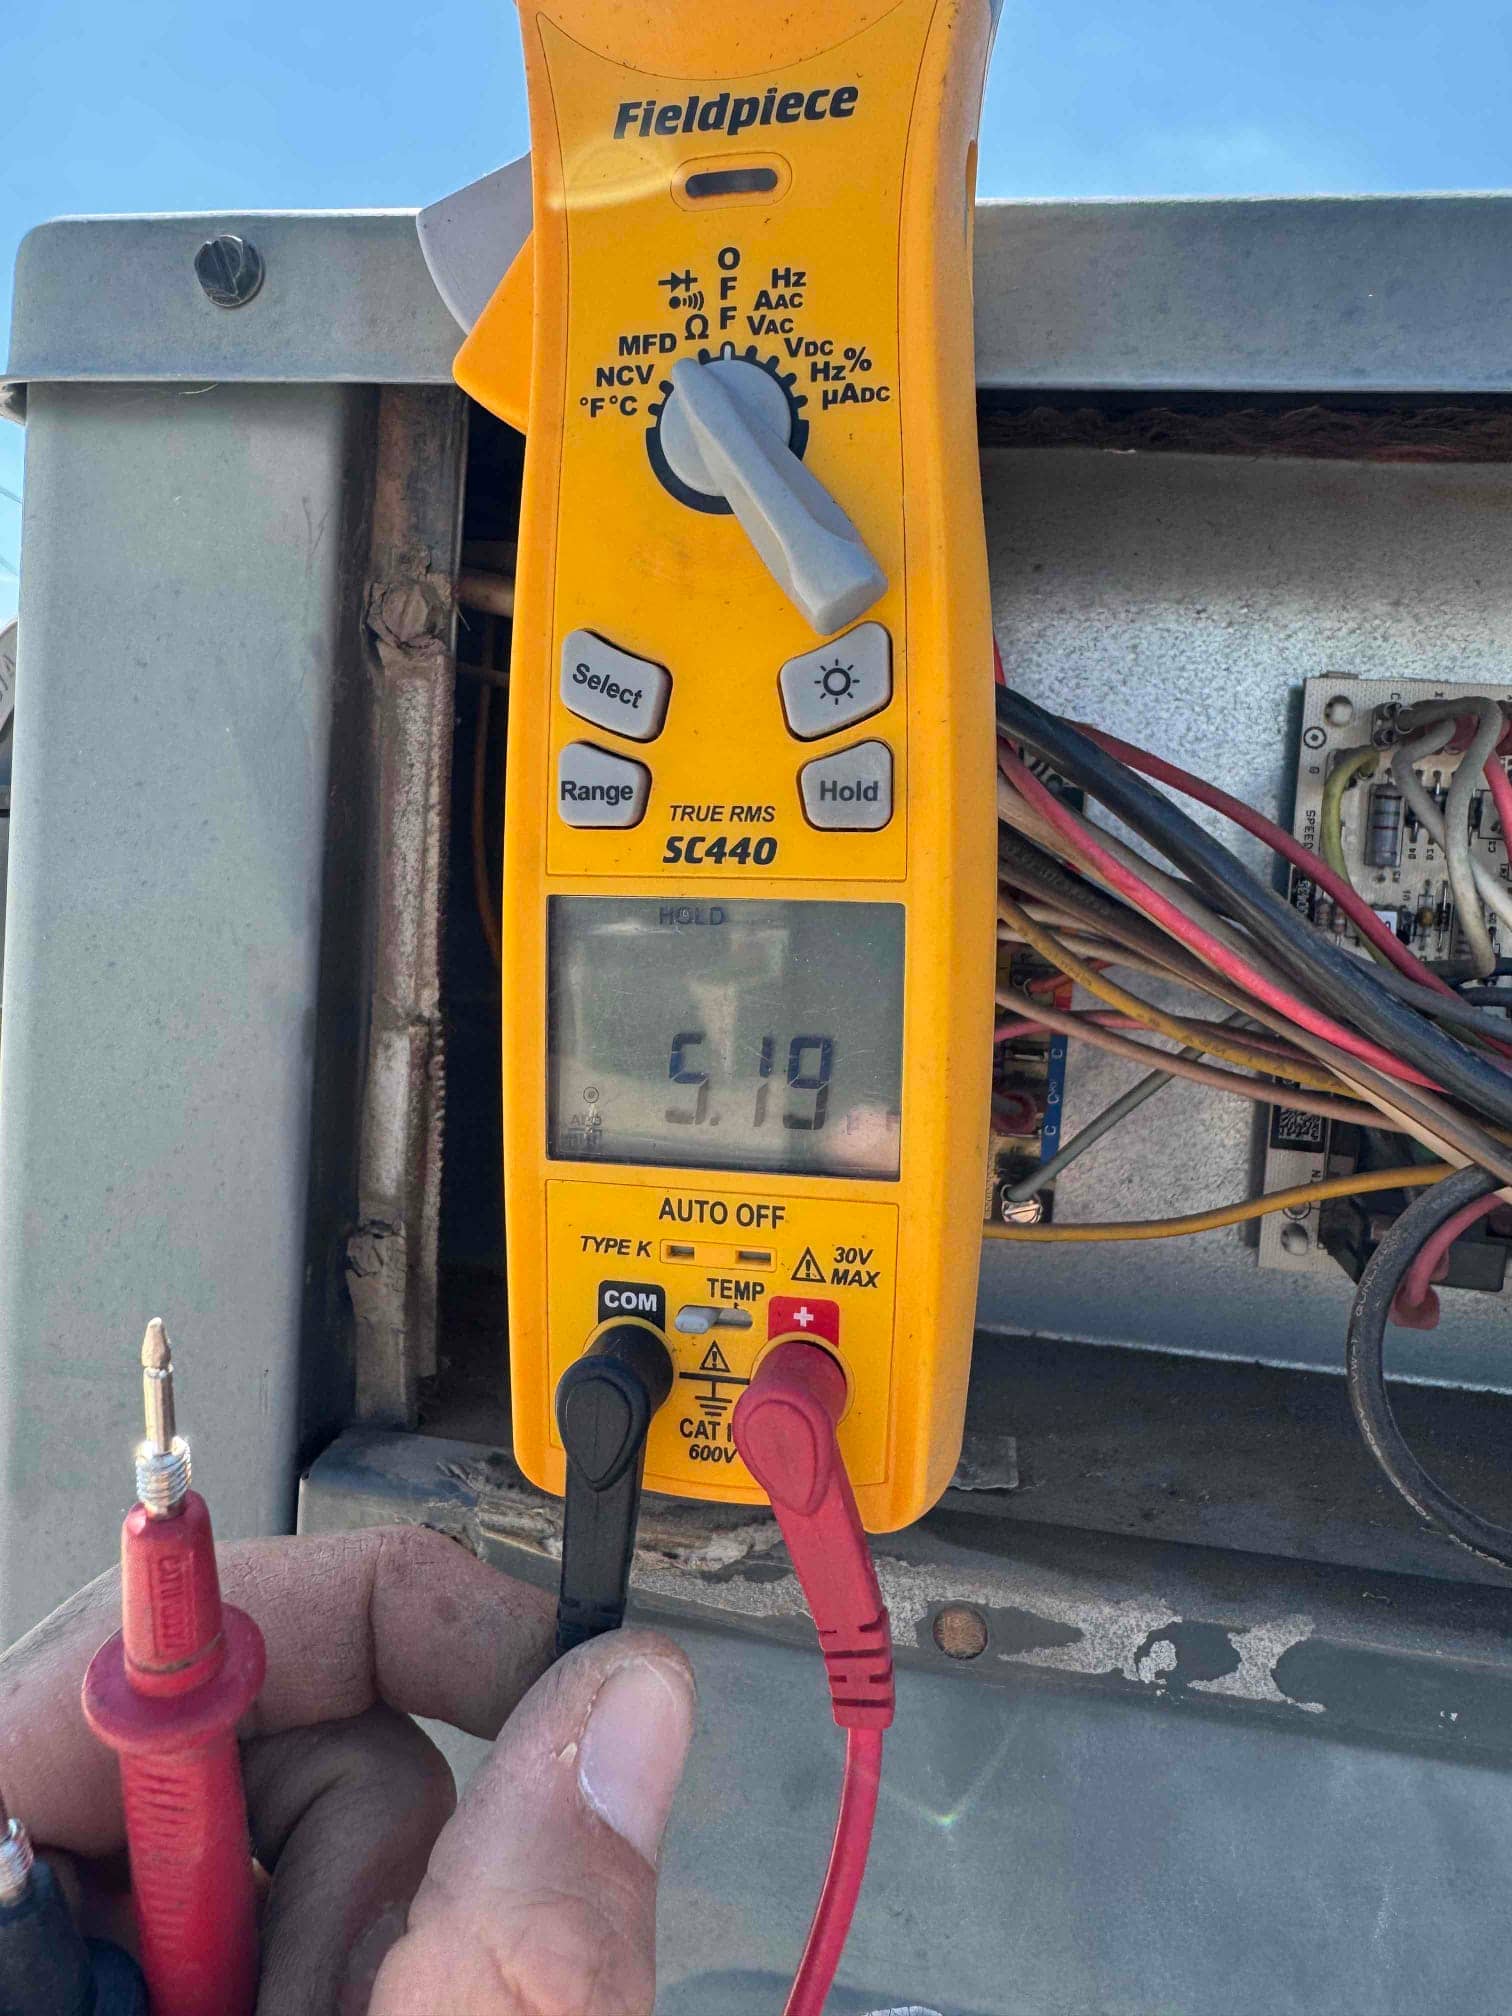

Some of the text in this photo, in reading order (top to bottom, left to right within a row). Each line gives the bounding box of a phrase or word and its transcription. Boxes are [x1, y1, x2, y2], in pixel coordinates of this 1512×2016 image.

[613, 86, 859, 140] Fieldpiece
[771, 267, 807, 289] Hz
[618, 333, 677, 356] MFD
[596, 364, 654, 387] NCV
[572, 663, 643, 709] Select
[560, 780, 634, 806] Range
[819, 781, 879, 802] Hold
[669, 804, 777, 823] TRUE RMS
[662, 836, 778, 866] SC440
[658, 906, 726, 926] HOLD
[664, 1032, 835, 1131] 5.19
[658, 1197, 786, 1229] AUTO OFF
[580, 1235, 653, 1258] TYPE K
[833, 1246, 875, 1266] 30V
[706, 1277, 765, 1302] TEMP
[830, 1269, 880, 1288] MAX
[603, 1290, 658, 1312] COM
[679, 1417, 722, 1440] CAT
[688, 1444, 738, 1465] 600V
